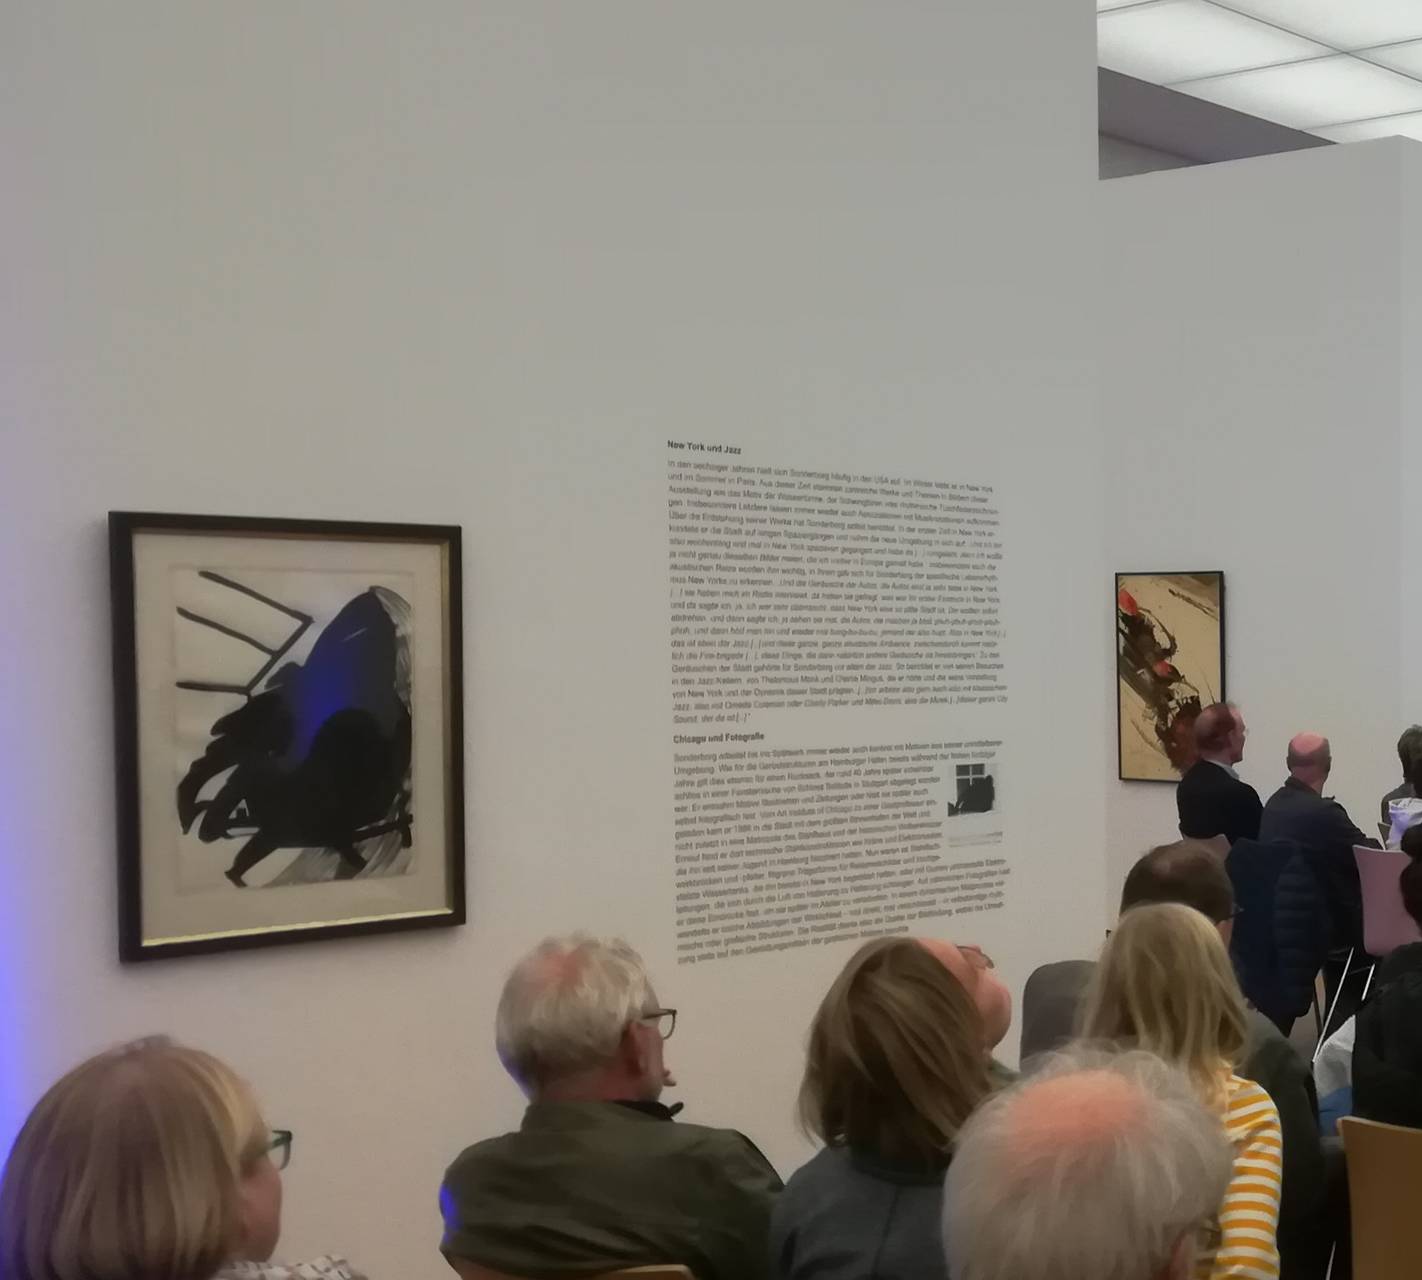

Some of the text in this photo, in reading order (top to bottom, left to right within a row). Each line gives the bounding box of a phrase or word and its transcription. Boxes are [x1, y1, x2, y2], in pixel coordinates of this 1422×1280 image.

[667, 440, 741, 455] New York und Jazz
[673, 732, 764, 745] Chicago und Fotografie
